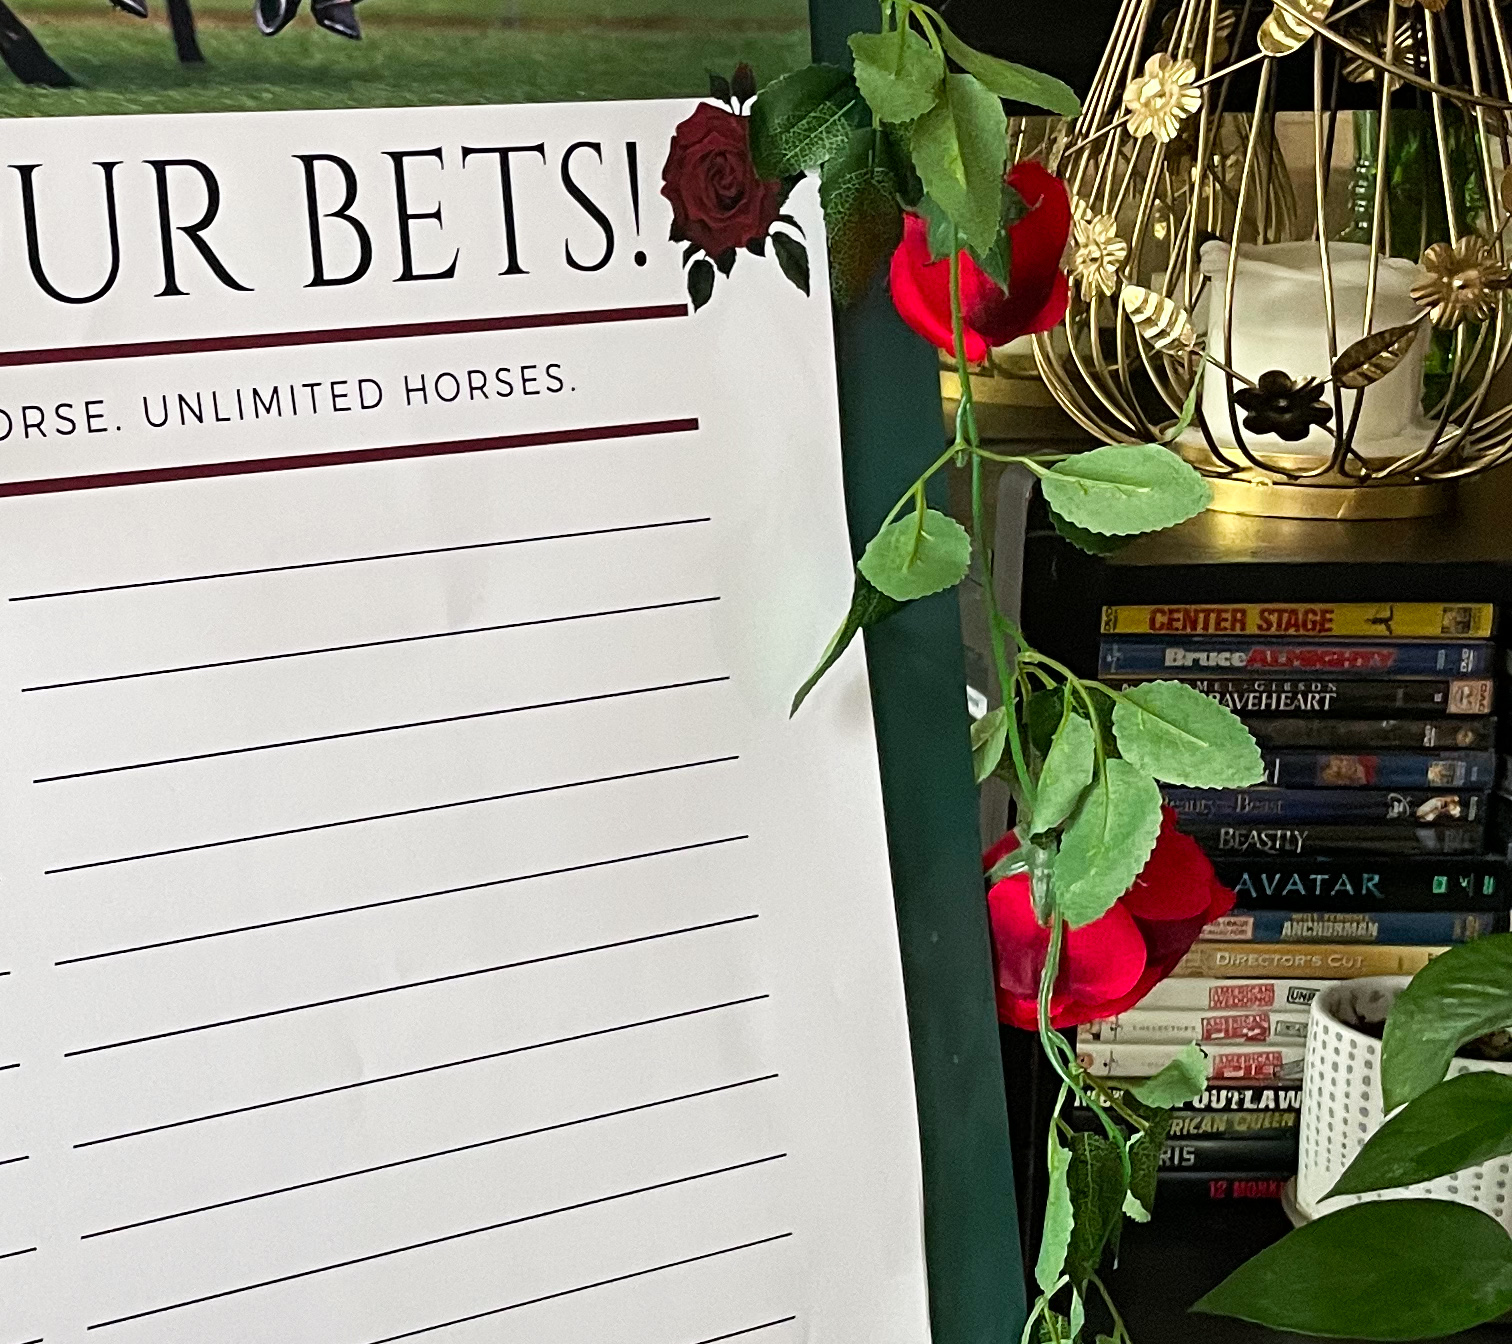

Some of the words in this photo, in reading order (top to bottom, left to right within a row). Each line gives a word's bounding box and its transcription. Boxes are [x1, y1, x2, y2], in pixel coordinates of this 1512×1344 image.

[292, 140, 648, 289] BETS!
[141, 376, 383, 430] UNLIMITED
[404, 361, 577, 407] HORSES.
[1149, 608, 1247, 633] CENTER
[1256, 608, 1335, 633] STAGE
[1208, 692, 1337, 711] RAVEHEART
[1218, 827, 1309, 854] BEASTLY
[1234, 872, 1385, 899] AVATAR
[1280, 921, 1379, 940] ANCHORMAN
[1216, 950, 1322, 968] DIRECTOR'S
[1327, 951, 1364, 968] CUT
[1170, 1114, 1228, 1136] RICAN
